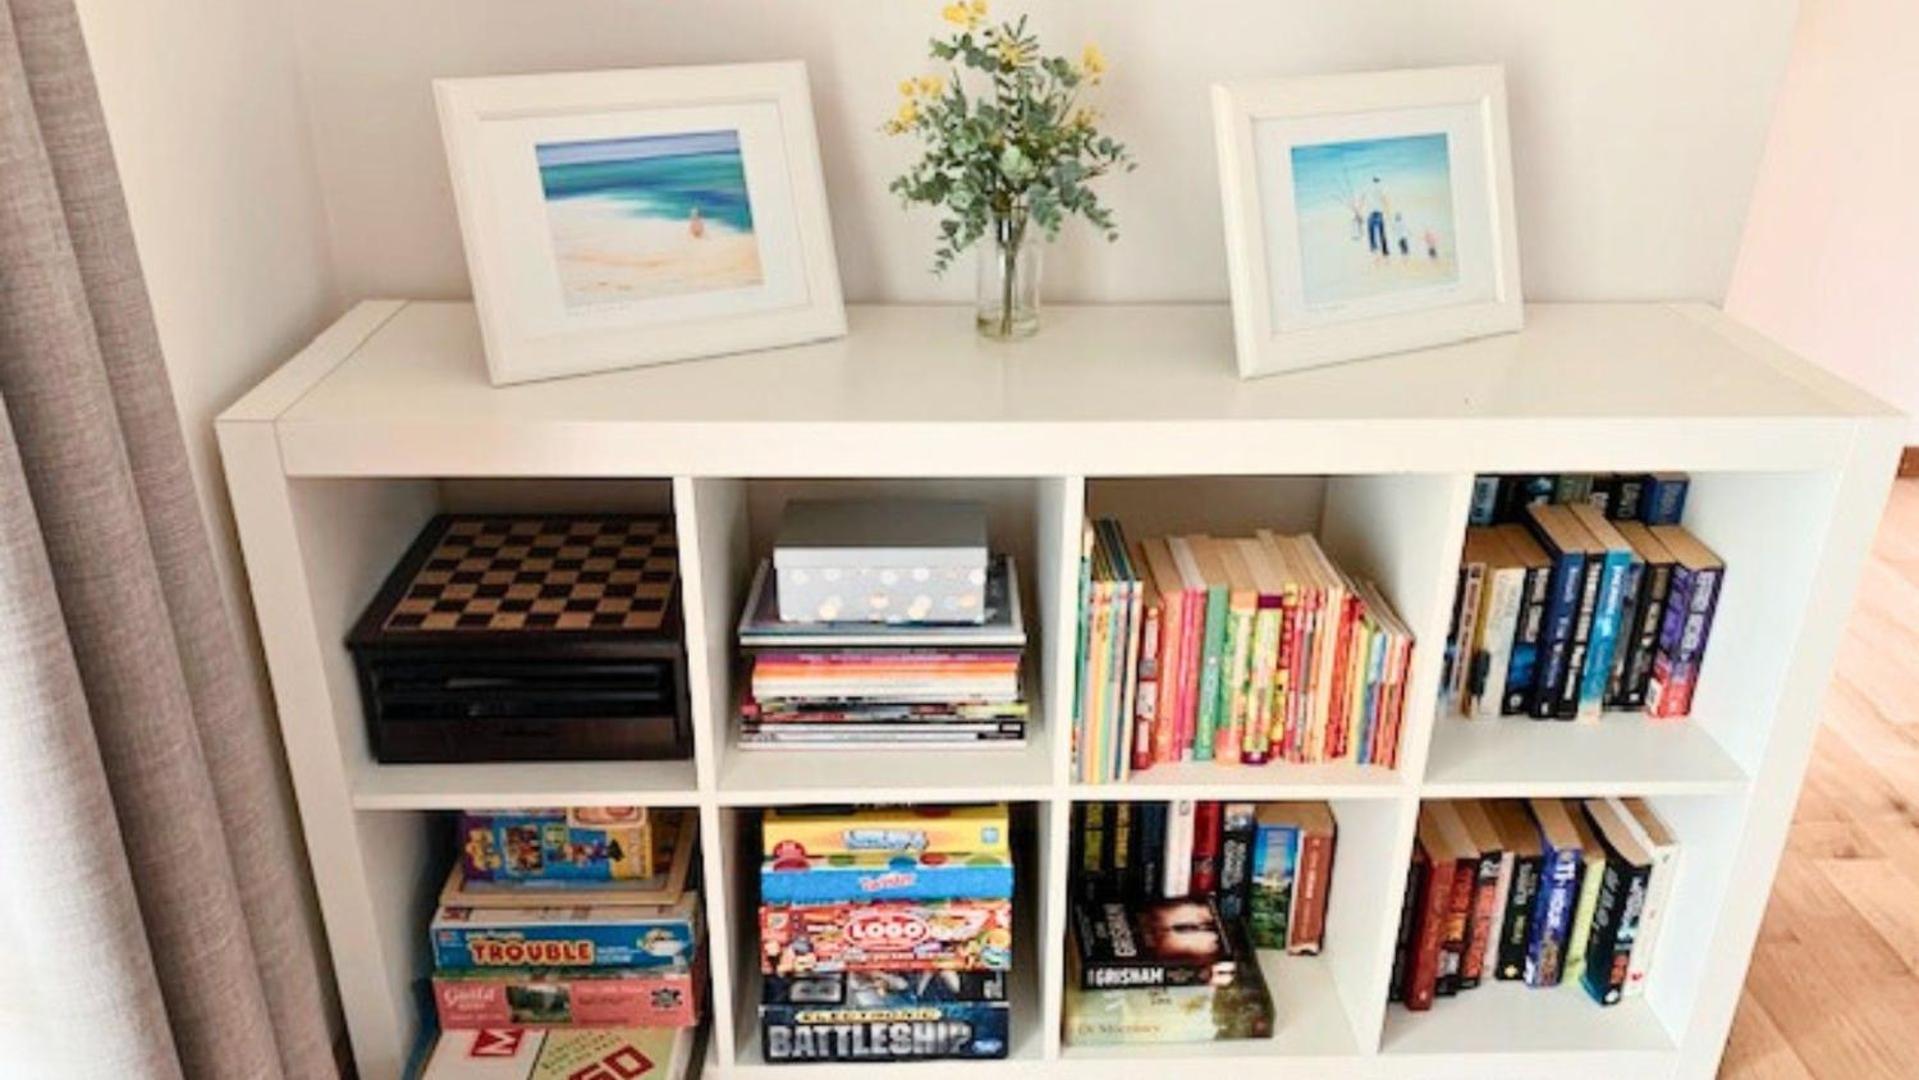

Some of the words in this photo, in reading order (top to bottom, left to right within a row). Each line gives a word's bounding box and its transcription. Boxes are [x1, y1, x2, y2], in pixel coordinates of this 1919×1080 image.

[852, 920, 924, 940] LOGO
[469, 939, 595, 966] TROUBLE
[1096, 967, 1165, 986] GRISHAM
[768, 1021, 971, 1057] BATTLESHIP
